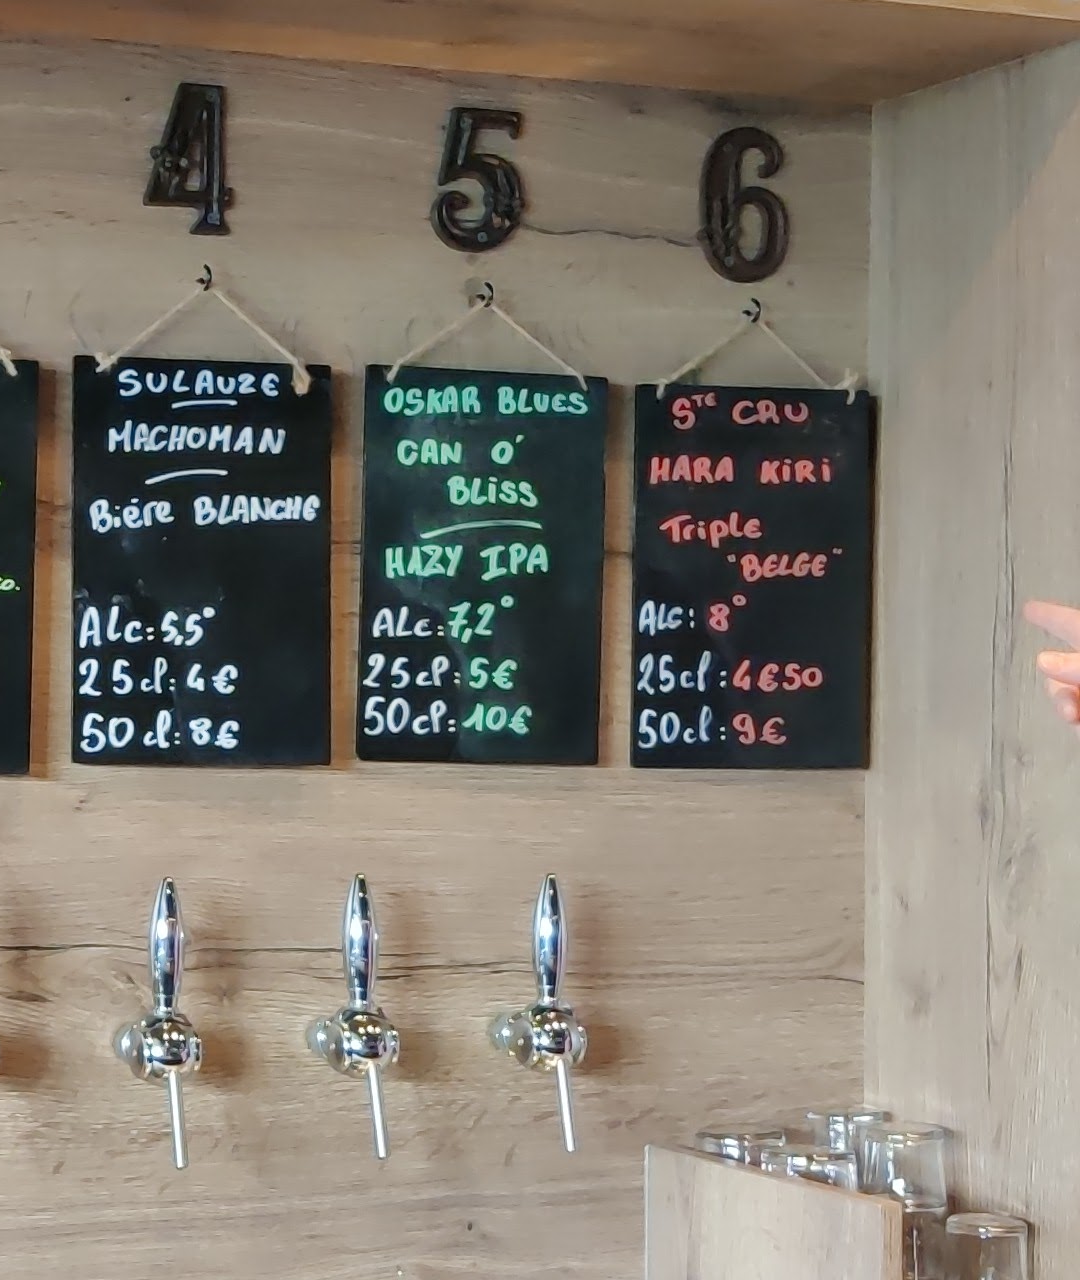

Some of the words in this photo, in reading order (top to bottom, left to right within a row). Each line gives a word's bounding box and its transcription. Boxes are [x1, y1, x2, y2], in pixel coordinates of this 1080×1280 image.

[147, 81, 233, 237] 4
[428, 106, 527, 252] 5
[699, 124, 790, 284] 6
[119, 368, 280, 397] SULAUZE
[384, 386, 482, 415] OSKAR
[497, 386, 588, 415] BLUES
[732, 400, 808, 425] CRU
[107, 420, 286, 455] MACHOMAN
[397, 438, 462, 465] CAN
[649, 456, 734, 484] HARA
[193, 495, 320, 526] BLANCHE
[658, 513, 762, 548] Triple
[385, 544, 462, 578] HAZY
[480, 543, 548, 580] IPA
[707, 594, 746, 632] 8°
[186, 664, 240, 695] 4€
[468, 658, 518, 690] 5€
[733, 661, 822, 690] 4€50
[189, 717, 240, 750] 8€
[462, 704, 532, 734] 10€
[733, 715, 787, 745] 9€
